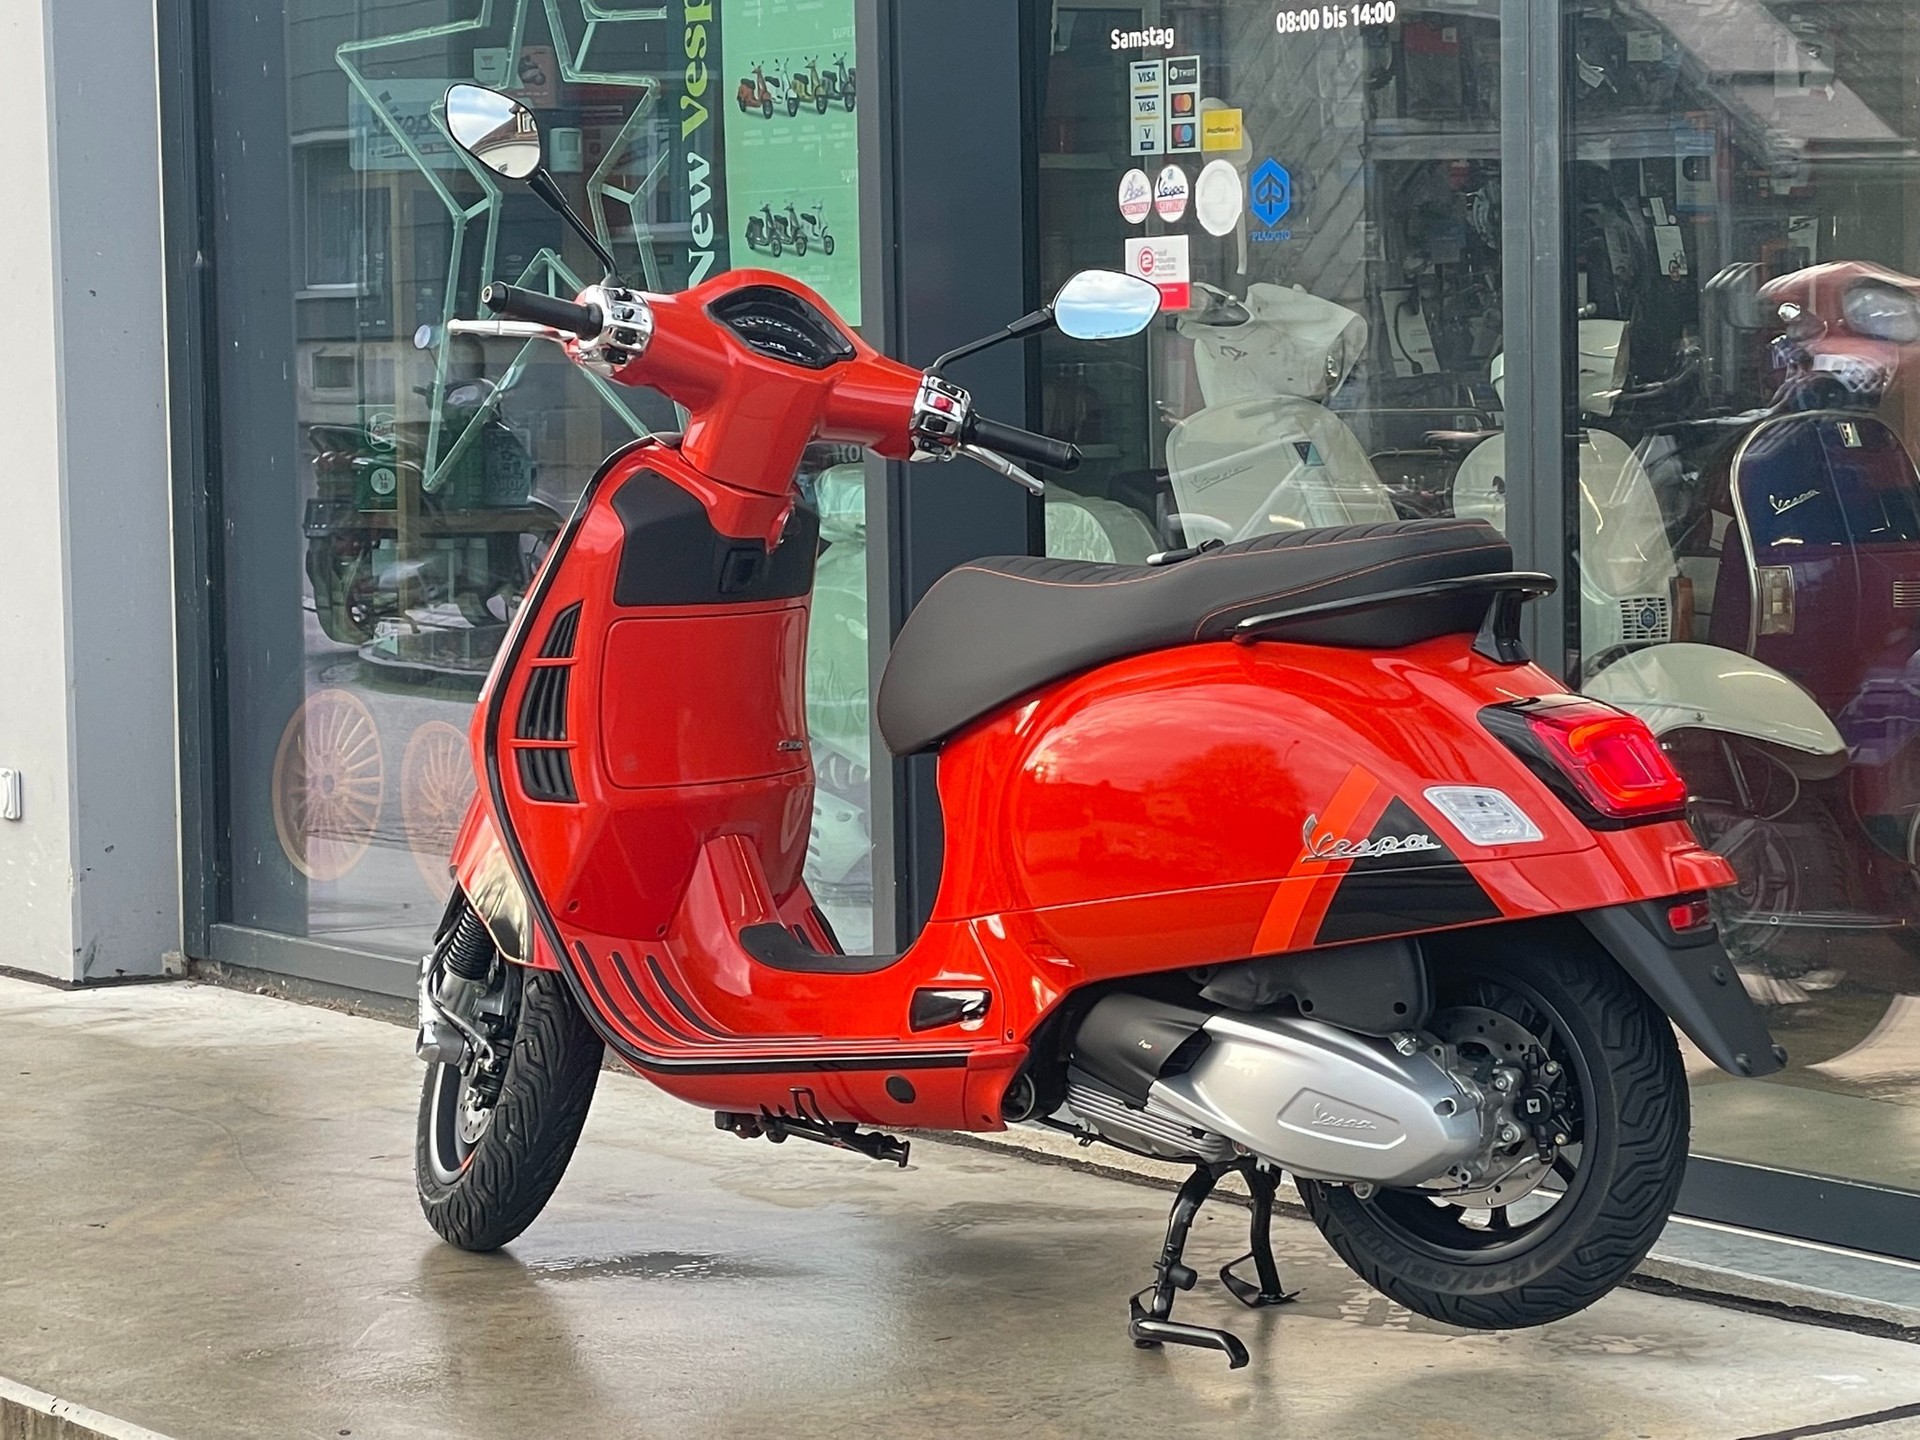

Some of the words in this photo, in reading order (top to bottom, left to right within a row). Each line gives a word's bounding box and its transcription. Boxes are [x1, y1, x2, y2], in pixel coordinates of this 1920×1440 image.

[1276, 9, 1320, 34] 08:00
[1322, 5, 1347, 29] bis
[1351, 1, 1396, 26] 14:00
[1110, 26, 1175, 50] Samstag
[1137, 71, 1156, 83] VISA
[1137, 101, 1156, 112] VISA
[1156, 176, 1186, 199] Vespa
[687, 152, 715, 290] New
[1251, 230, 1291, 242] PIAGGIO
[1768, 489, 1821, 516] Vespa
[1300, 814, 1442, 864] Vespa
[1311, 1102, 1378, 1130] Vespa
